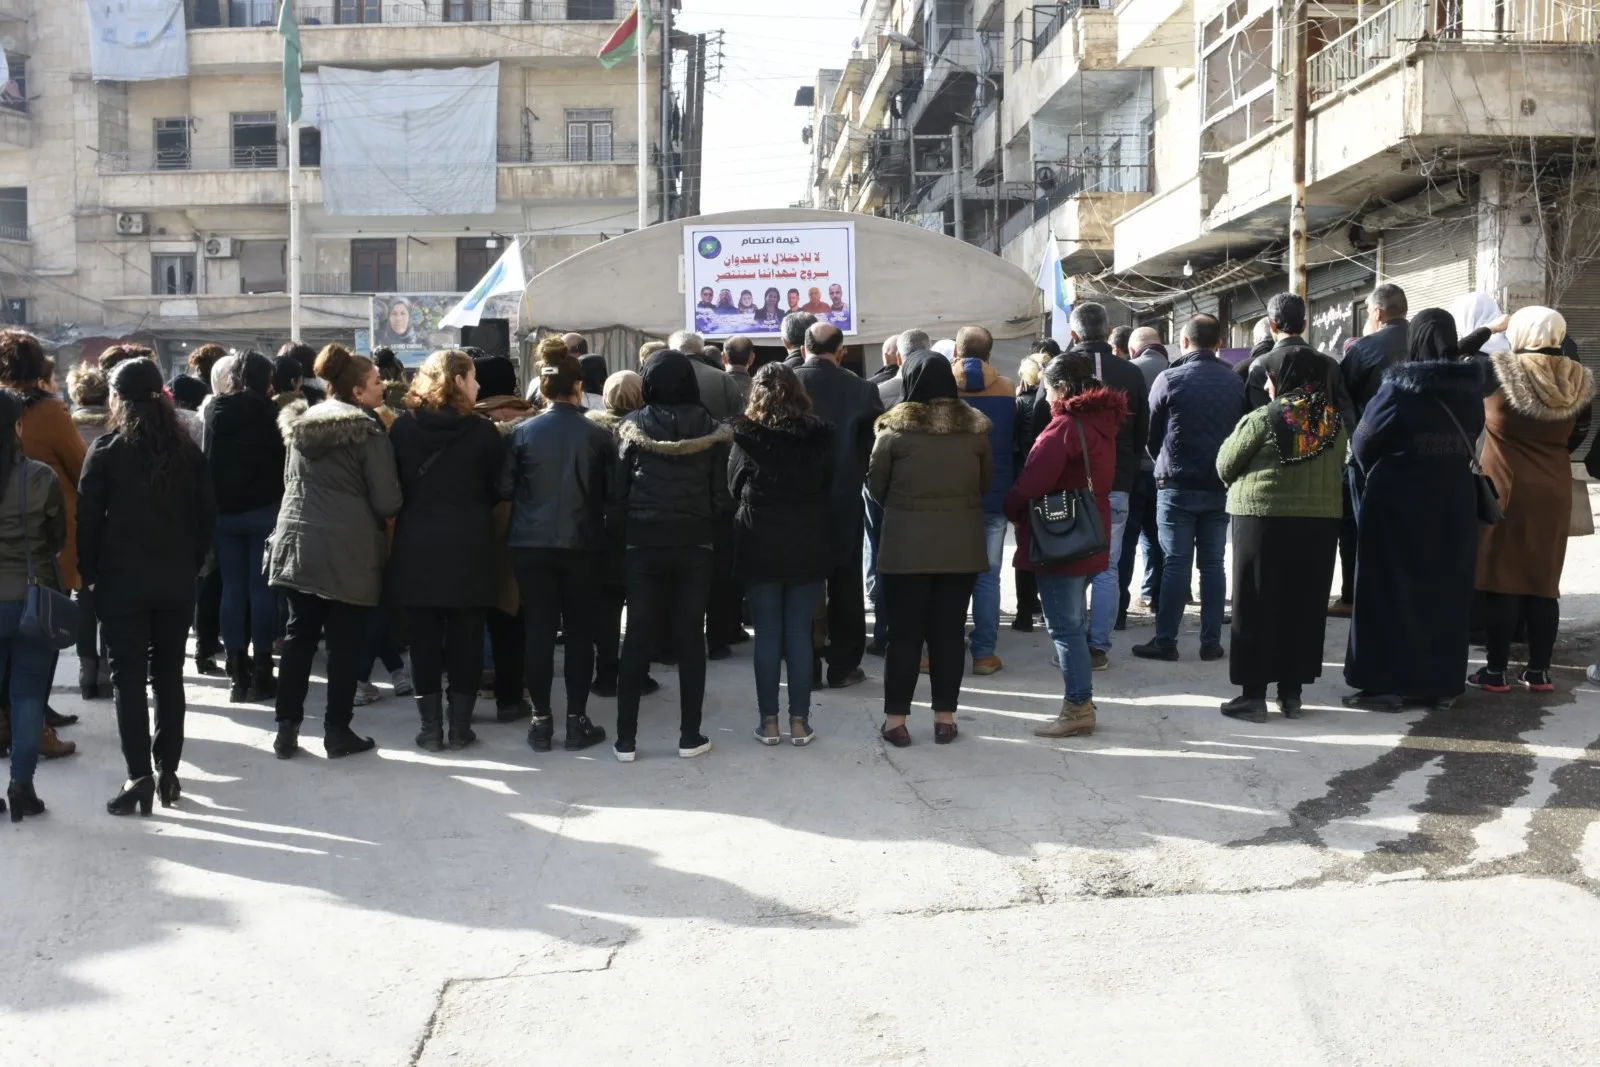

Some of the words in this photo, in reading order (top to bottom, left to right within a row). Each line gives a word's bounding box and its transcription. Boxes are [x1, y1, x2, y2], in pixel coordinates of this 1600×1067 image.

[741, 236, 774, 247] اعتصام
[776, 236, 800, 245] خيمة
[723, 253, 760, 267] للعدوان
[715, 269, 756, 282] سننتصر
